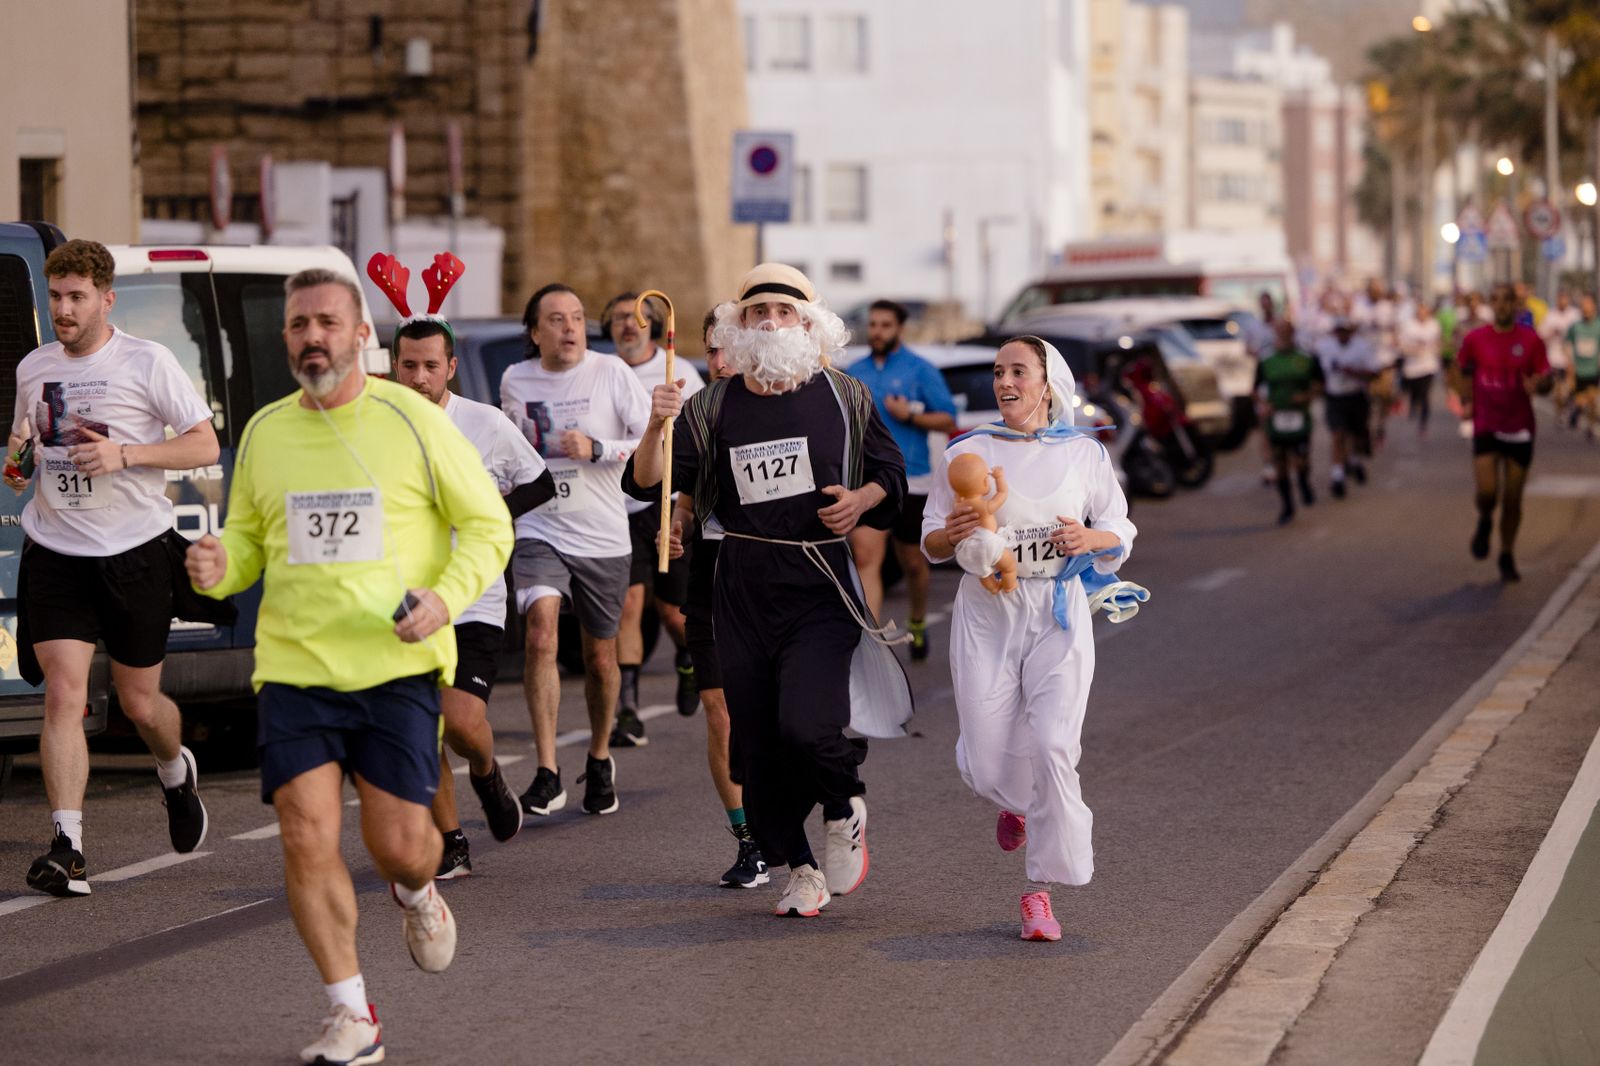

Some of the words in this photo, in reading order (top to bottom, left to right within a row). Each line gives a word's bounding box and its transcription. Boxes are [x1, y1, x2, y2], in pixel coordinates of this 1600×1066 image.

[736, 451, 766, 461] CIUDAD
[754, 441, 801, 451] SILVESTRE
[743, 454, 798, 483] 1127
[57, 473, 92, 493] 311
[308, 511, 359, 538] 372
